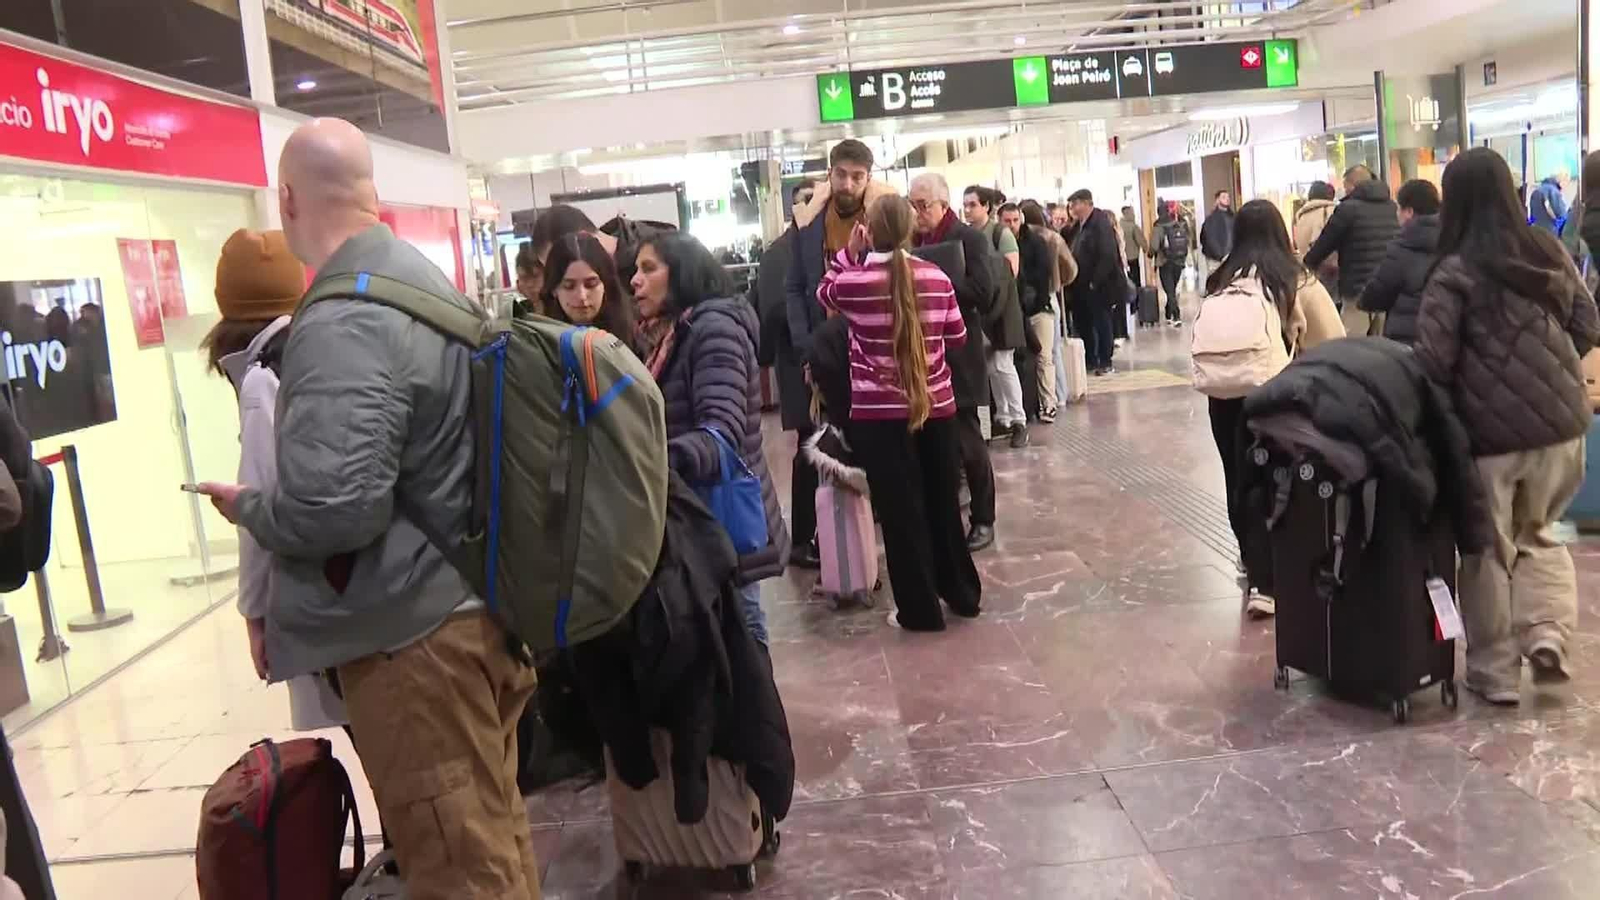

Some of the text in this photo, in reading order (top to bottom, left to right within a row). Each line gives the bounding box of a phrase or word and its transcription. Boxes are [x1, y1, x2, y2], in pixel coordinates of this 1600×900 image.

[909, 70, 946, 82] Acceso
[1052, 57, 1098, 73] Plaça de
[1053, 68, 1111, 86] Joan Peiró
[881, 73, 906, 110] B
[0, 67, 114, 158] cio iryo
[2, 331, 67, 390] iryo
